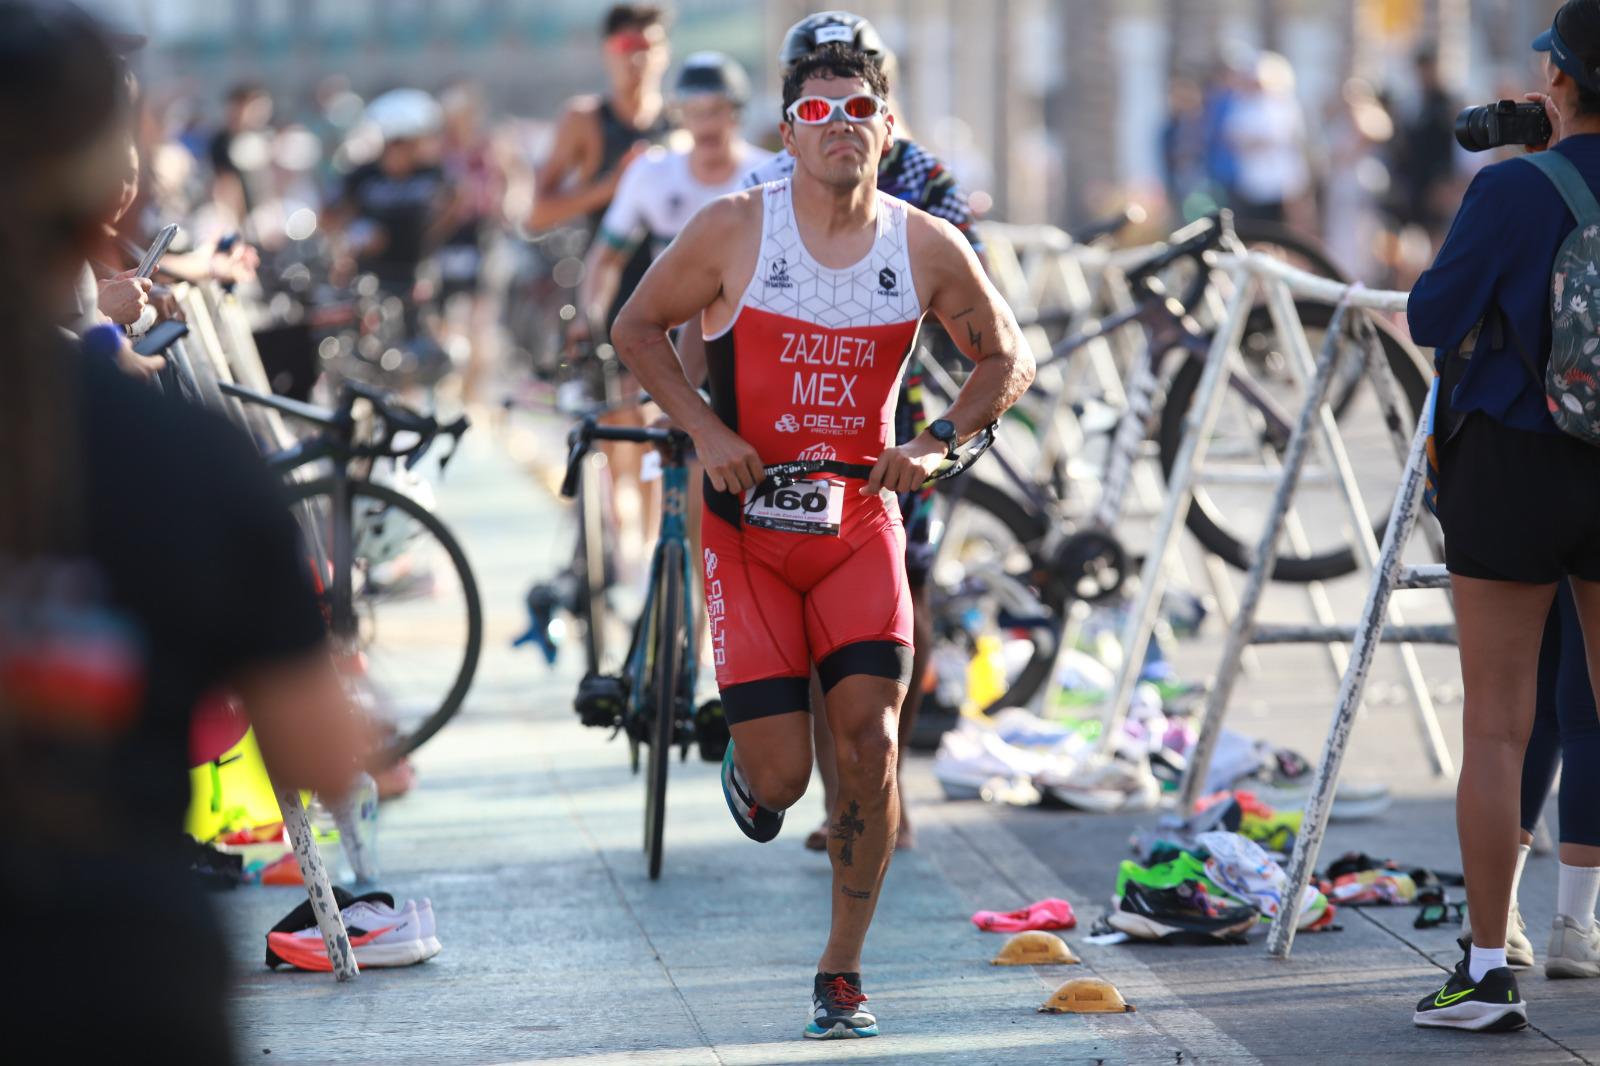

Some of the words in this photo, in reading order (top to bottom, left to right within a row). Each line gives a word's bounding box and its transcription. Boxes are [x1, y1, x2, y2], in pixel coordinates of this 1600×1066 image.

[780, 333, 875, 368] ZAZUETA
[792, 371, 858, 408] MEX
[803, 414, 865, 429] DELTA
[764, 490, 827, 513] 160
[711, 579, 726, 666] DELTA
